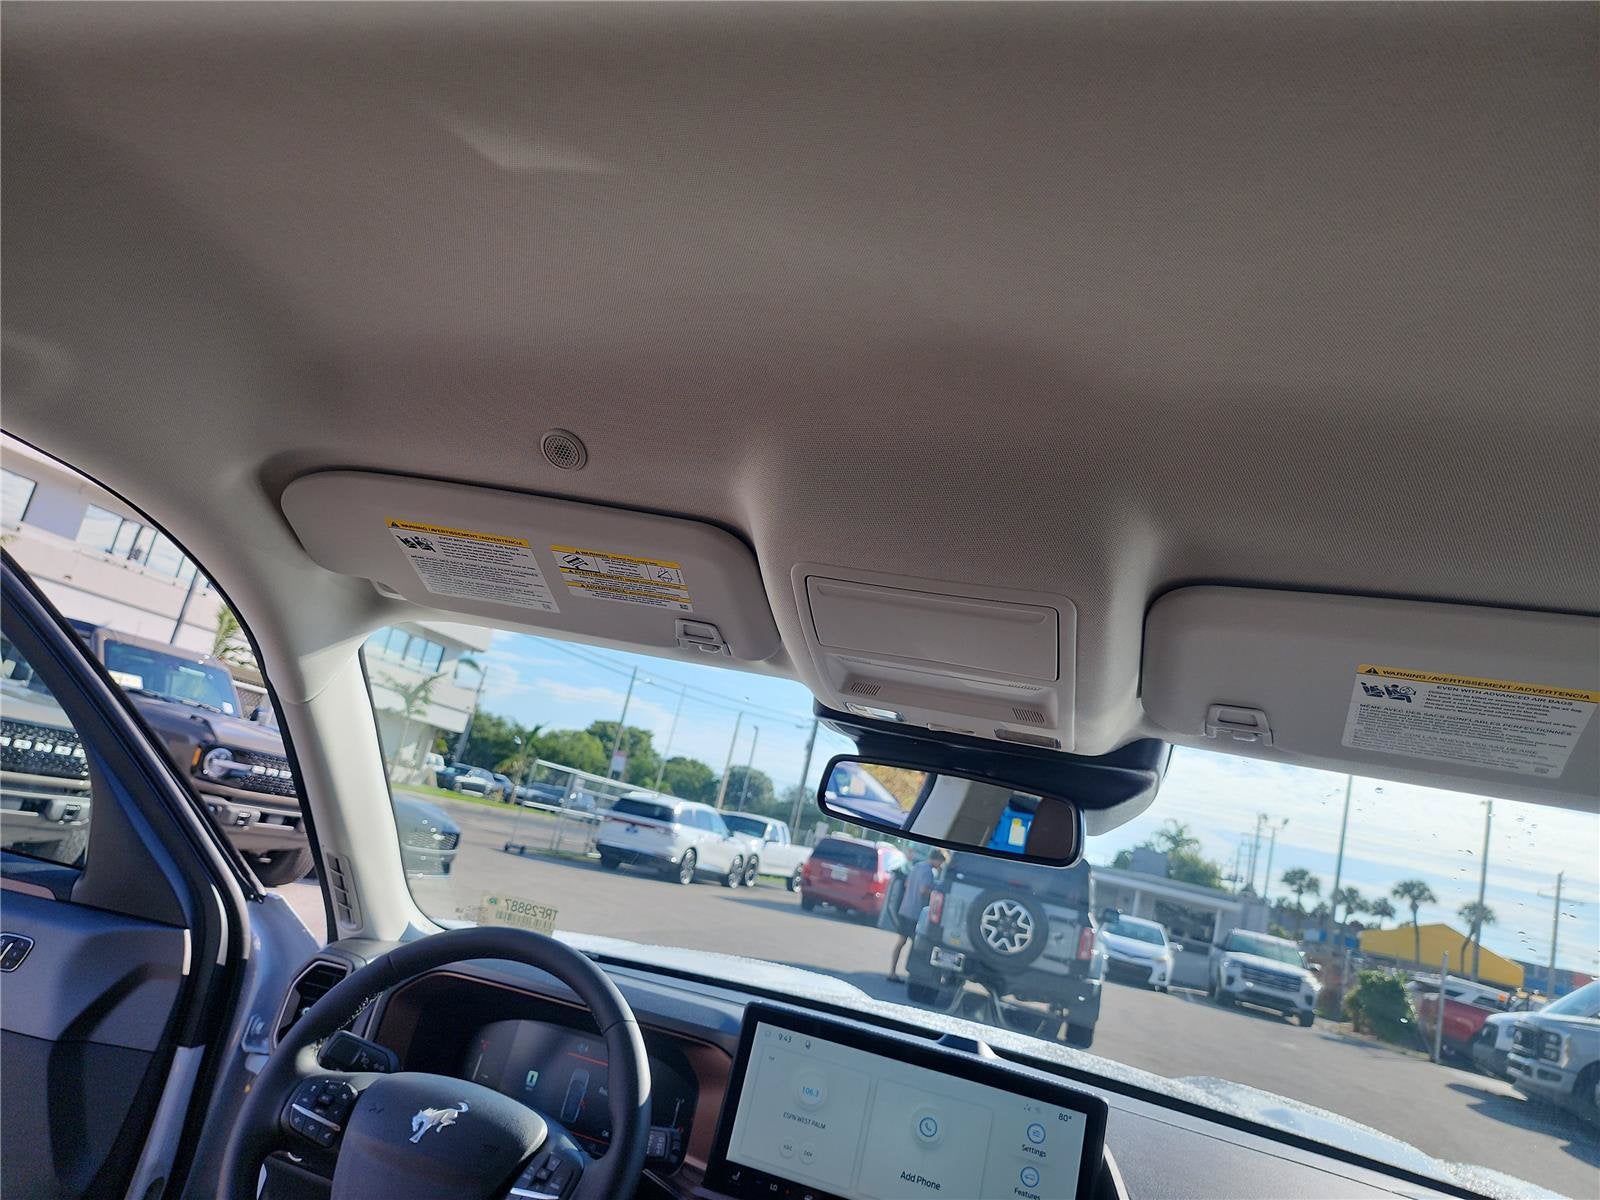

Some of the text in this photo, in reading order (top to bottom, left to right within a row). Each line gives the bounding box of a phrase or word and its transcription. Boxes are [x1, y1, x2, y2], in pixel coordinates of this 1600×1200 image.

[1382, 670, 1426, 679] WARNING
[1483, 691, 1530, 700] ADVANCED
[1021, 1143, 1047, 1158] Settings
[900, 1171, 941, 1191] Add Phone
[1014, 1187, 1041, 1200] Features
